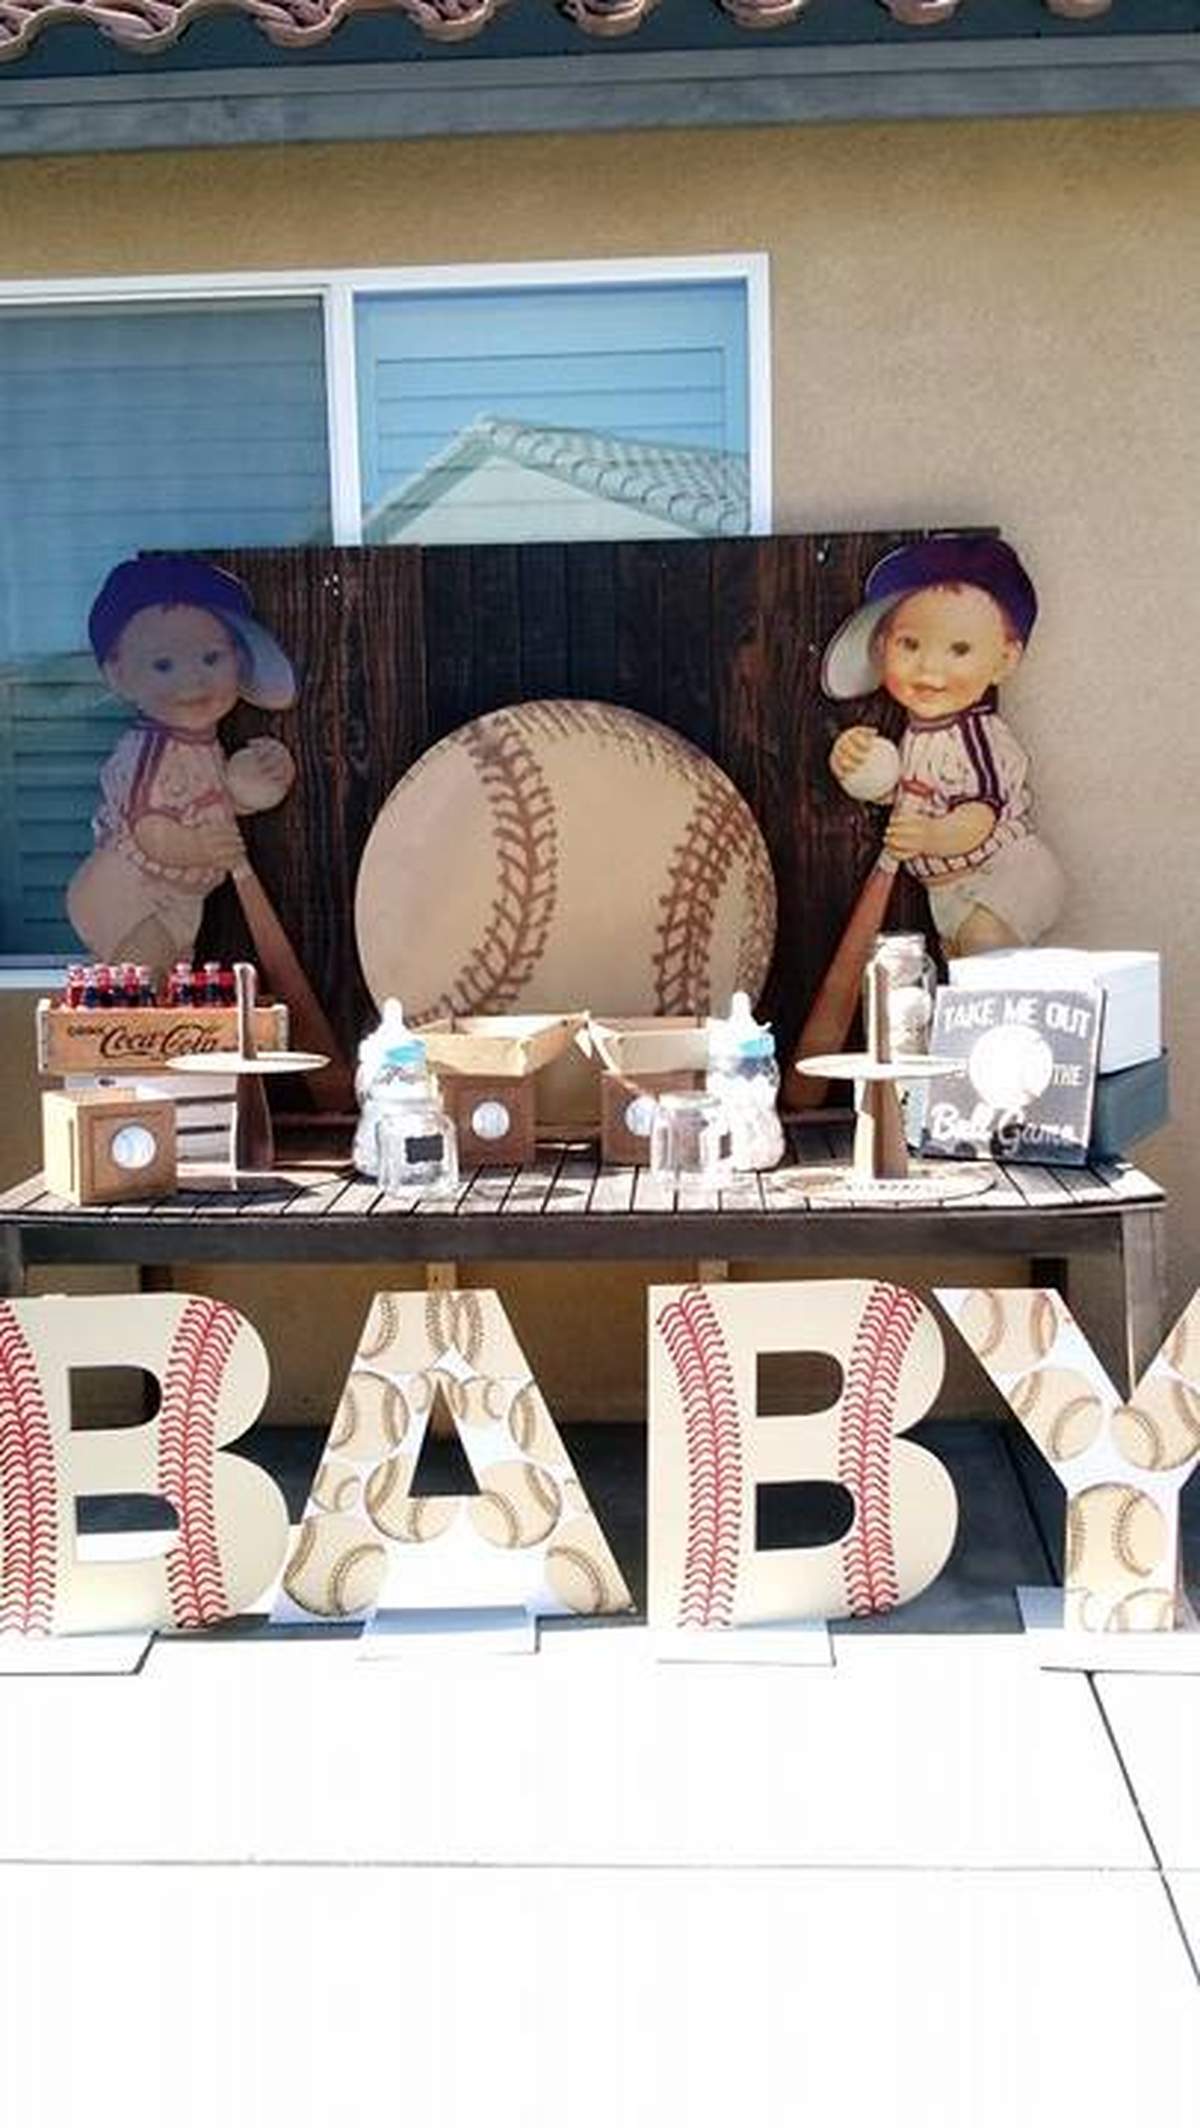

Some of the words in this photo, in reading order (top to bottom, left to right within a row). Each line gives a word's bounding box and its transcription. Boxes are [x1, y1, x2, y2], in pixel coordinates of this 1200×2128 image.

[943, 1001, 995, 1032] TAKE
[1003, 998, 1039, 1025] ME
[1045, 1002, 1091, 1039] OUT
[1053, 1063, 1085, 1087] THE
[931, 1103, 994, 1142] Ball
[0, 1281, 1200, 1637] BABY
